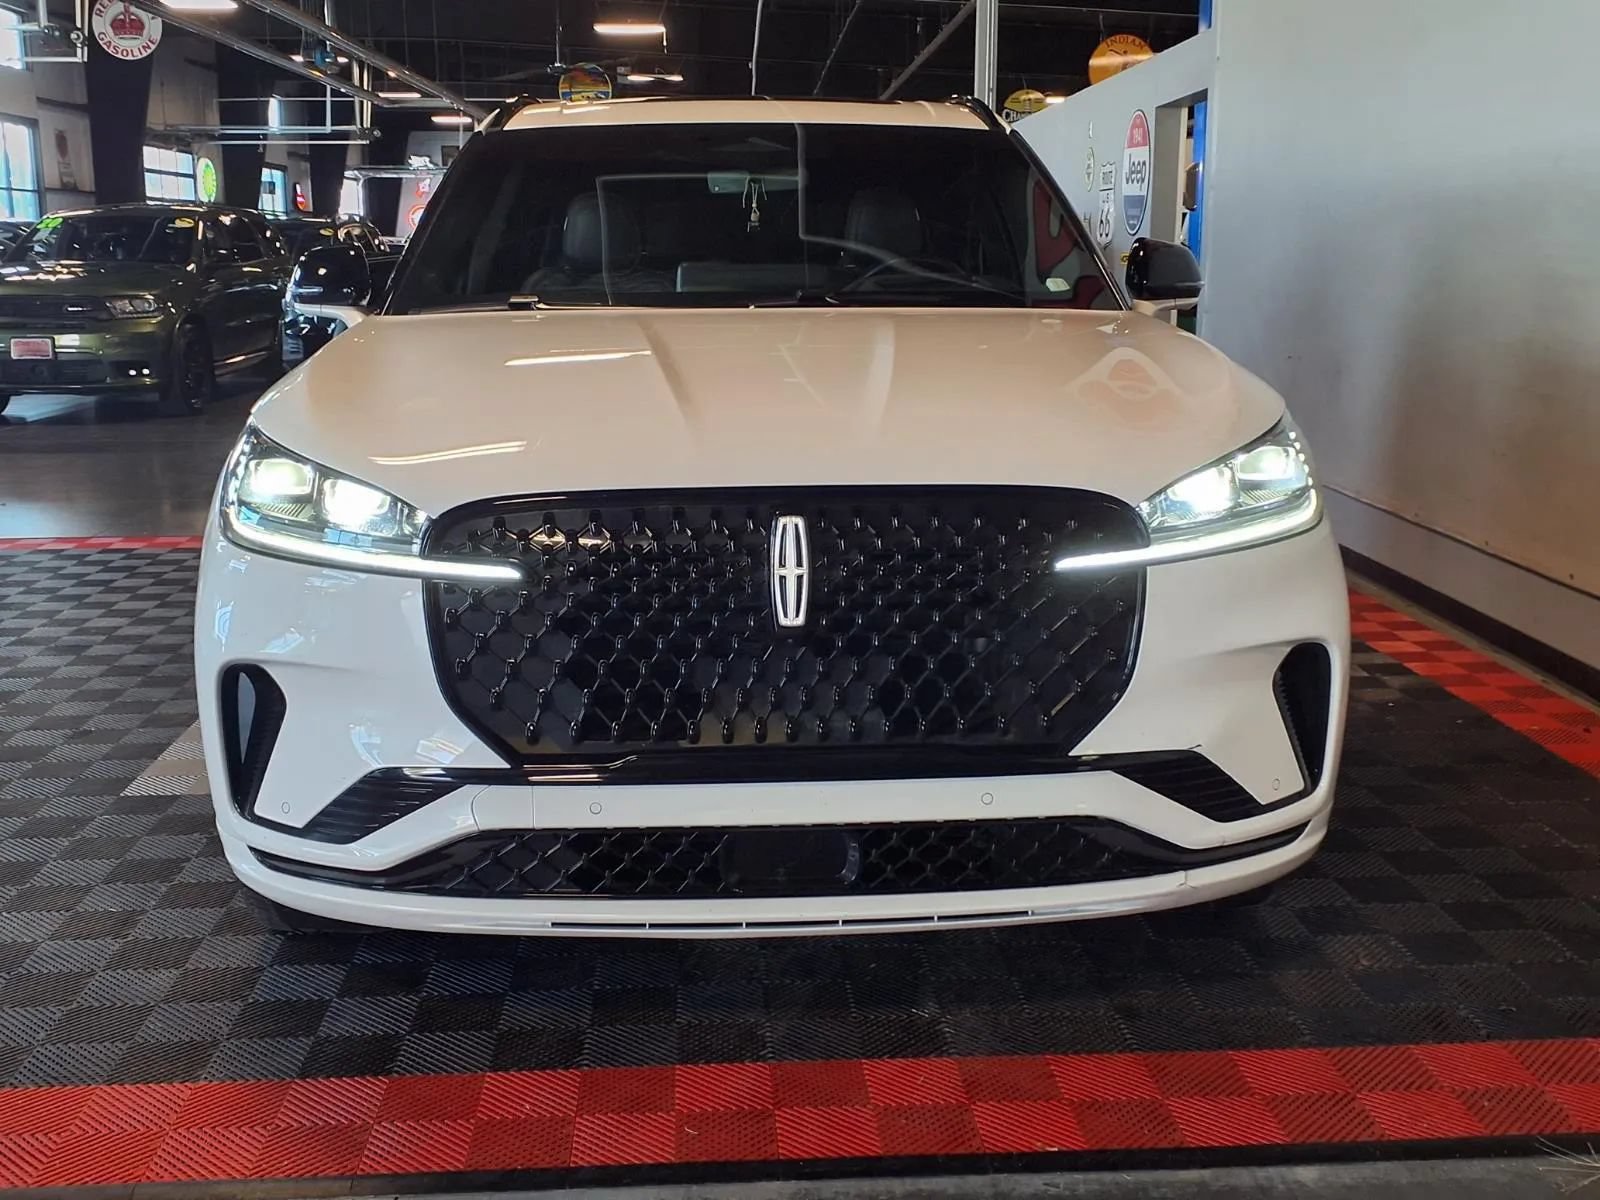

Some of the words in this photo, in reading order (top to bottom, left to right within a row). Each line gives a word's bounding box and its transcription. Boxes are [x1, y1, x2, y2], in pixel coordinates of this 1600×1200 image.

[97, 31, 158, 58] GASOLINE
[1105, 36, 1145, 50] INDIAN
[1125, 153, 1147, 191] Jeep
[1098, 206, 1111, 238] 66
